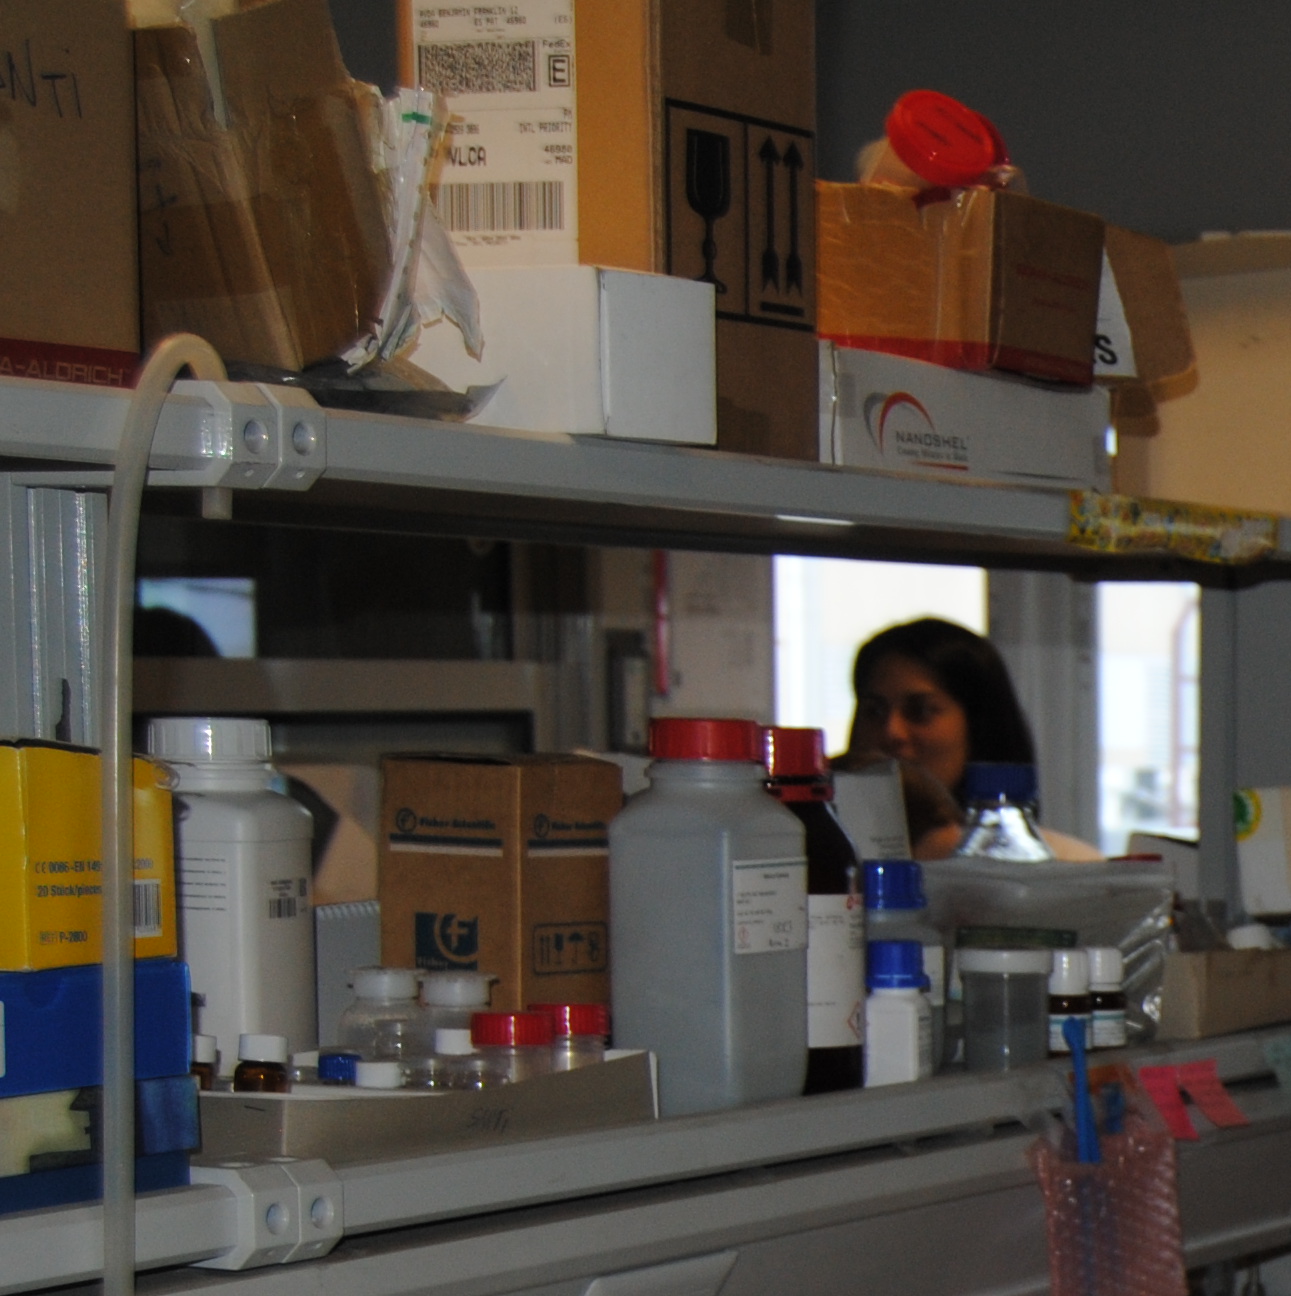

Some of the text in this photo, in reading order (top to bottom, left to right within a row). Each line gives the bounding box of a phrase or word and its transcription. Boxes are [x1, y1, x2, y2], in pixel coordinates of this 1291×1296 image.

[542, 40, 571, 49] FedEx
[552, 59, 567, 83] E
[538, 121, 573, 134] PRIORITY
